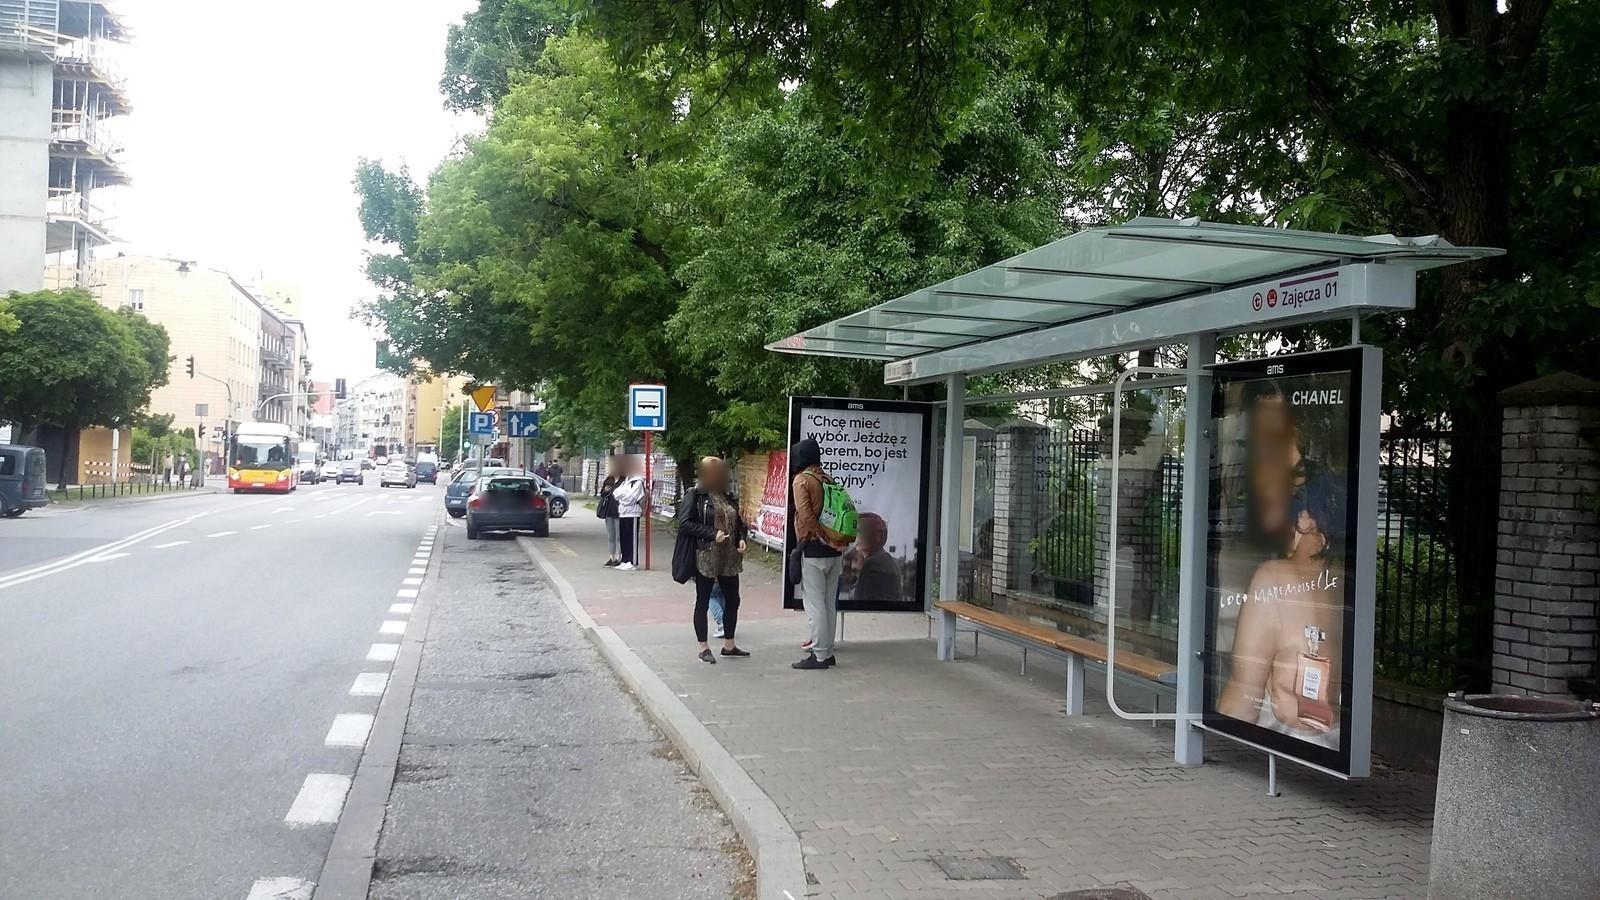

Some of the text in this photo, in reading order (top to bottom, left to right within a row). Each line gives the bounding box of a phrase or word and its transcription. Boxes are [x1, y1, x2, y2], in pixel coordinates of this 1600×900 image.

[1282, 288, 1320, 308] Zajęcza
[1325, 281, 1337, 298] 01
[1266, 364, 1284, 375] ams
[1292, 389, 1344, 406] CHANEL
[848, 402, 864, 410] ams
[475, 414, 489, 432] P
[849, 417, 881, 429] mieć
[807, 430, 907, 447] wybór. Jeżdżę z
[864, 446, 882, 458] bo
[884, 447, 908, 461] jest
[882, 462, 886, 473] i
